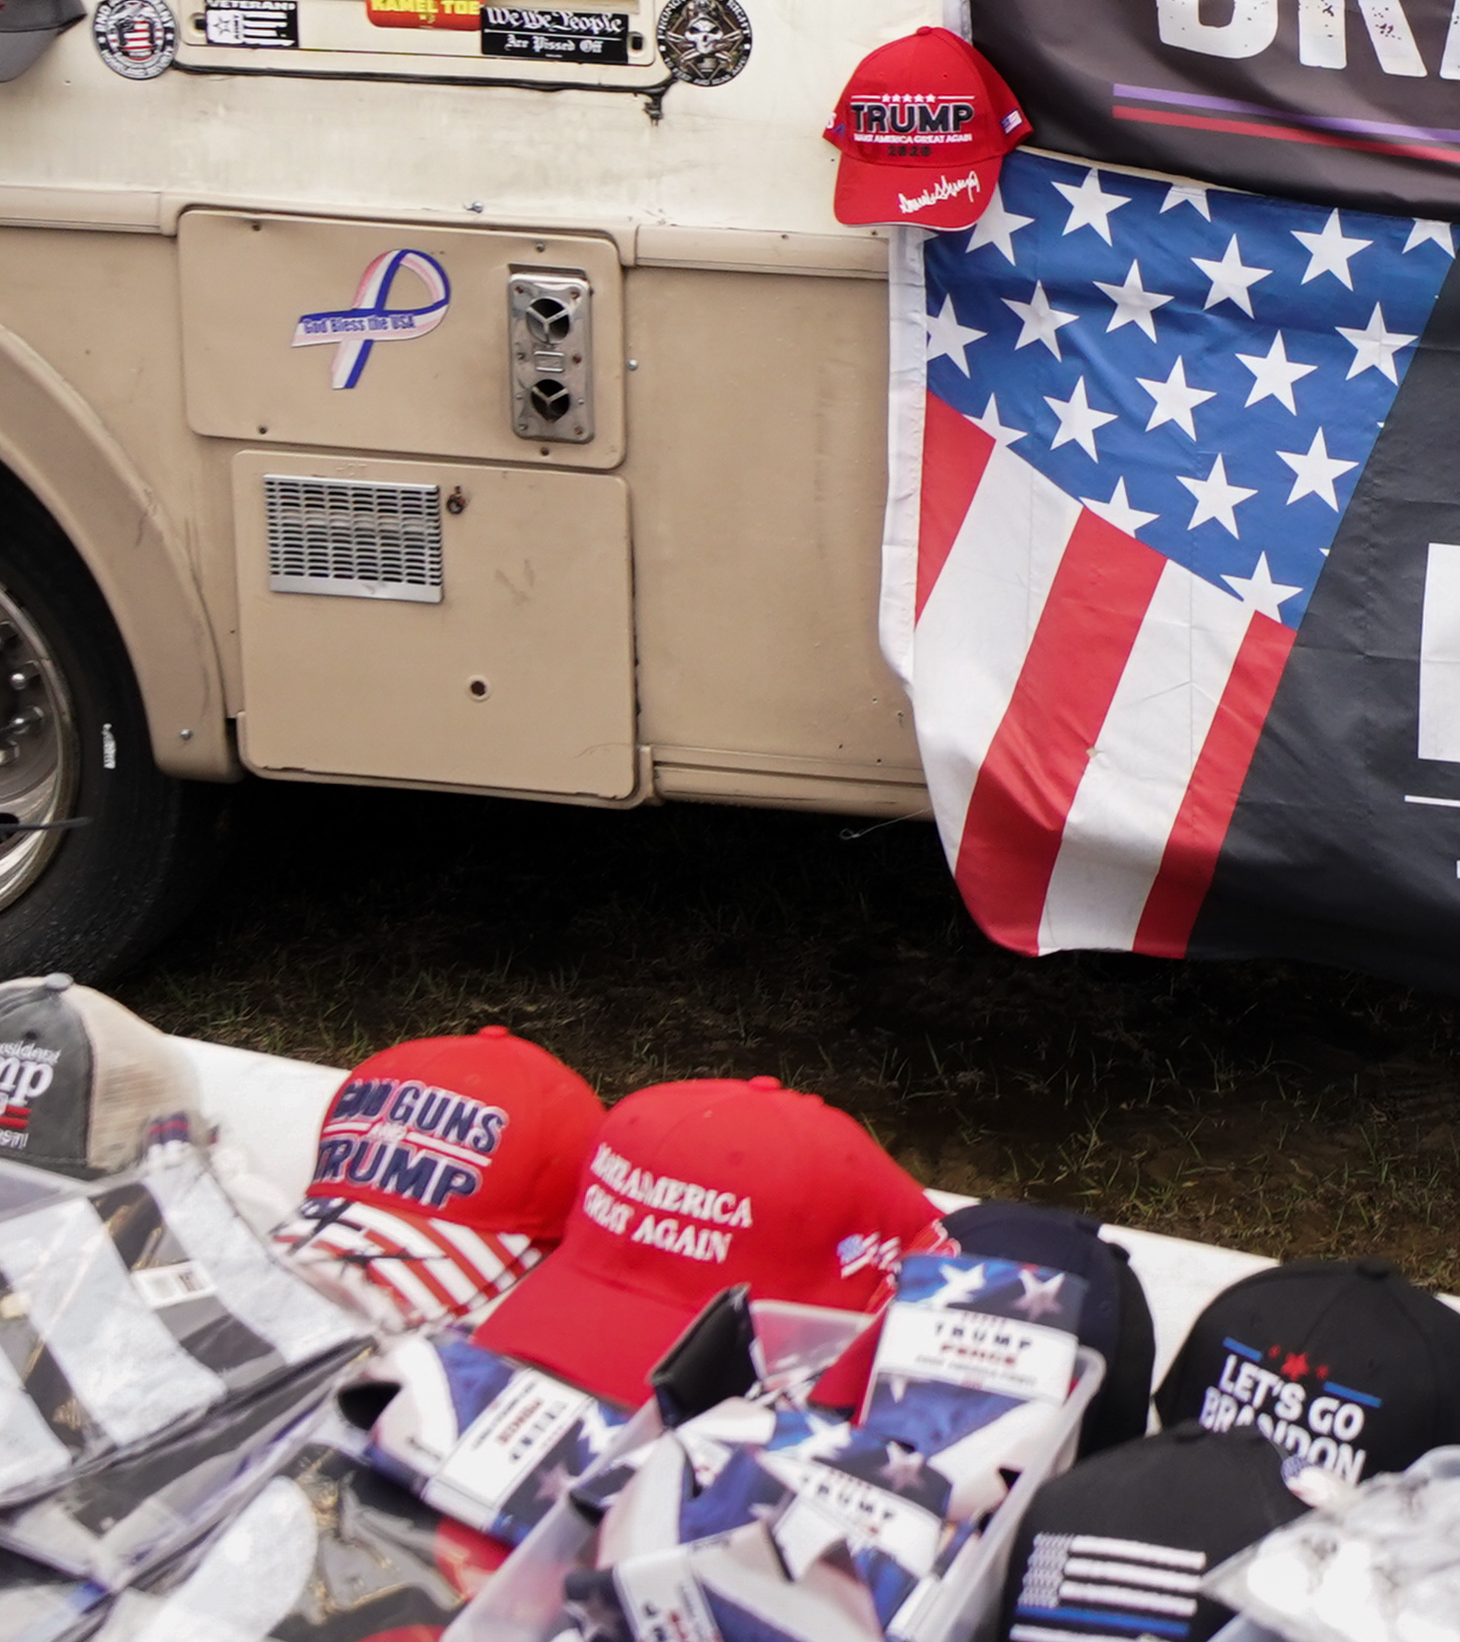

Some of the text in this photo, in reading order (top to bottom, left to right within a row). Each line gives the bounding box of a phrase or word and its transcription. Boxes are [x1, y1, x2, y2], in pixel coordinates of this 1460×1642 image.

[850, 102, 974, 134] TRUMP
[303, 313, 415, 334] God Bless the USA
[390, 1081, 510, 1154] GUNS
[1219, 1354, 1365, 1441] LET'S GO
